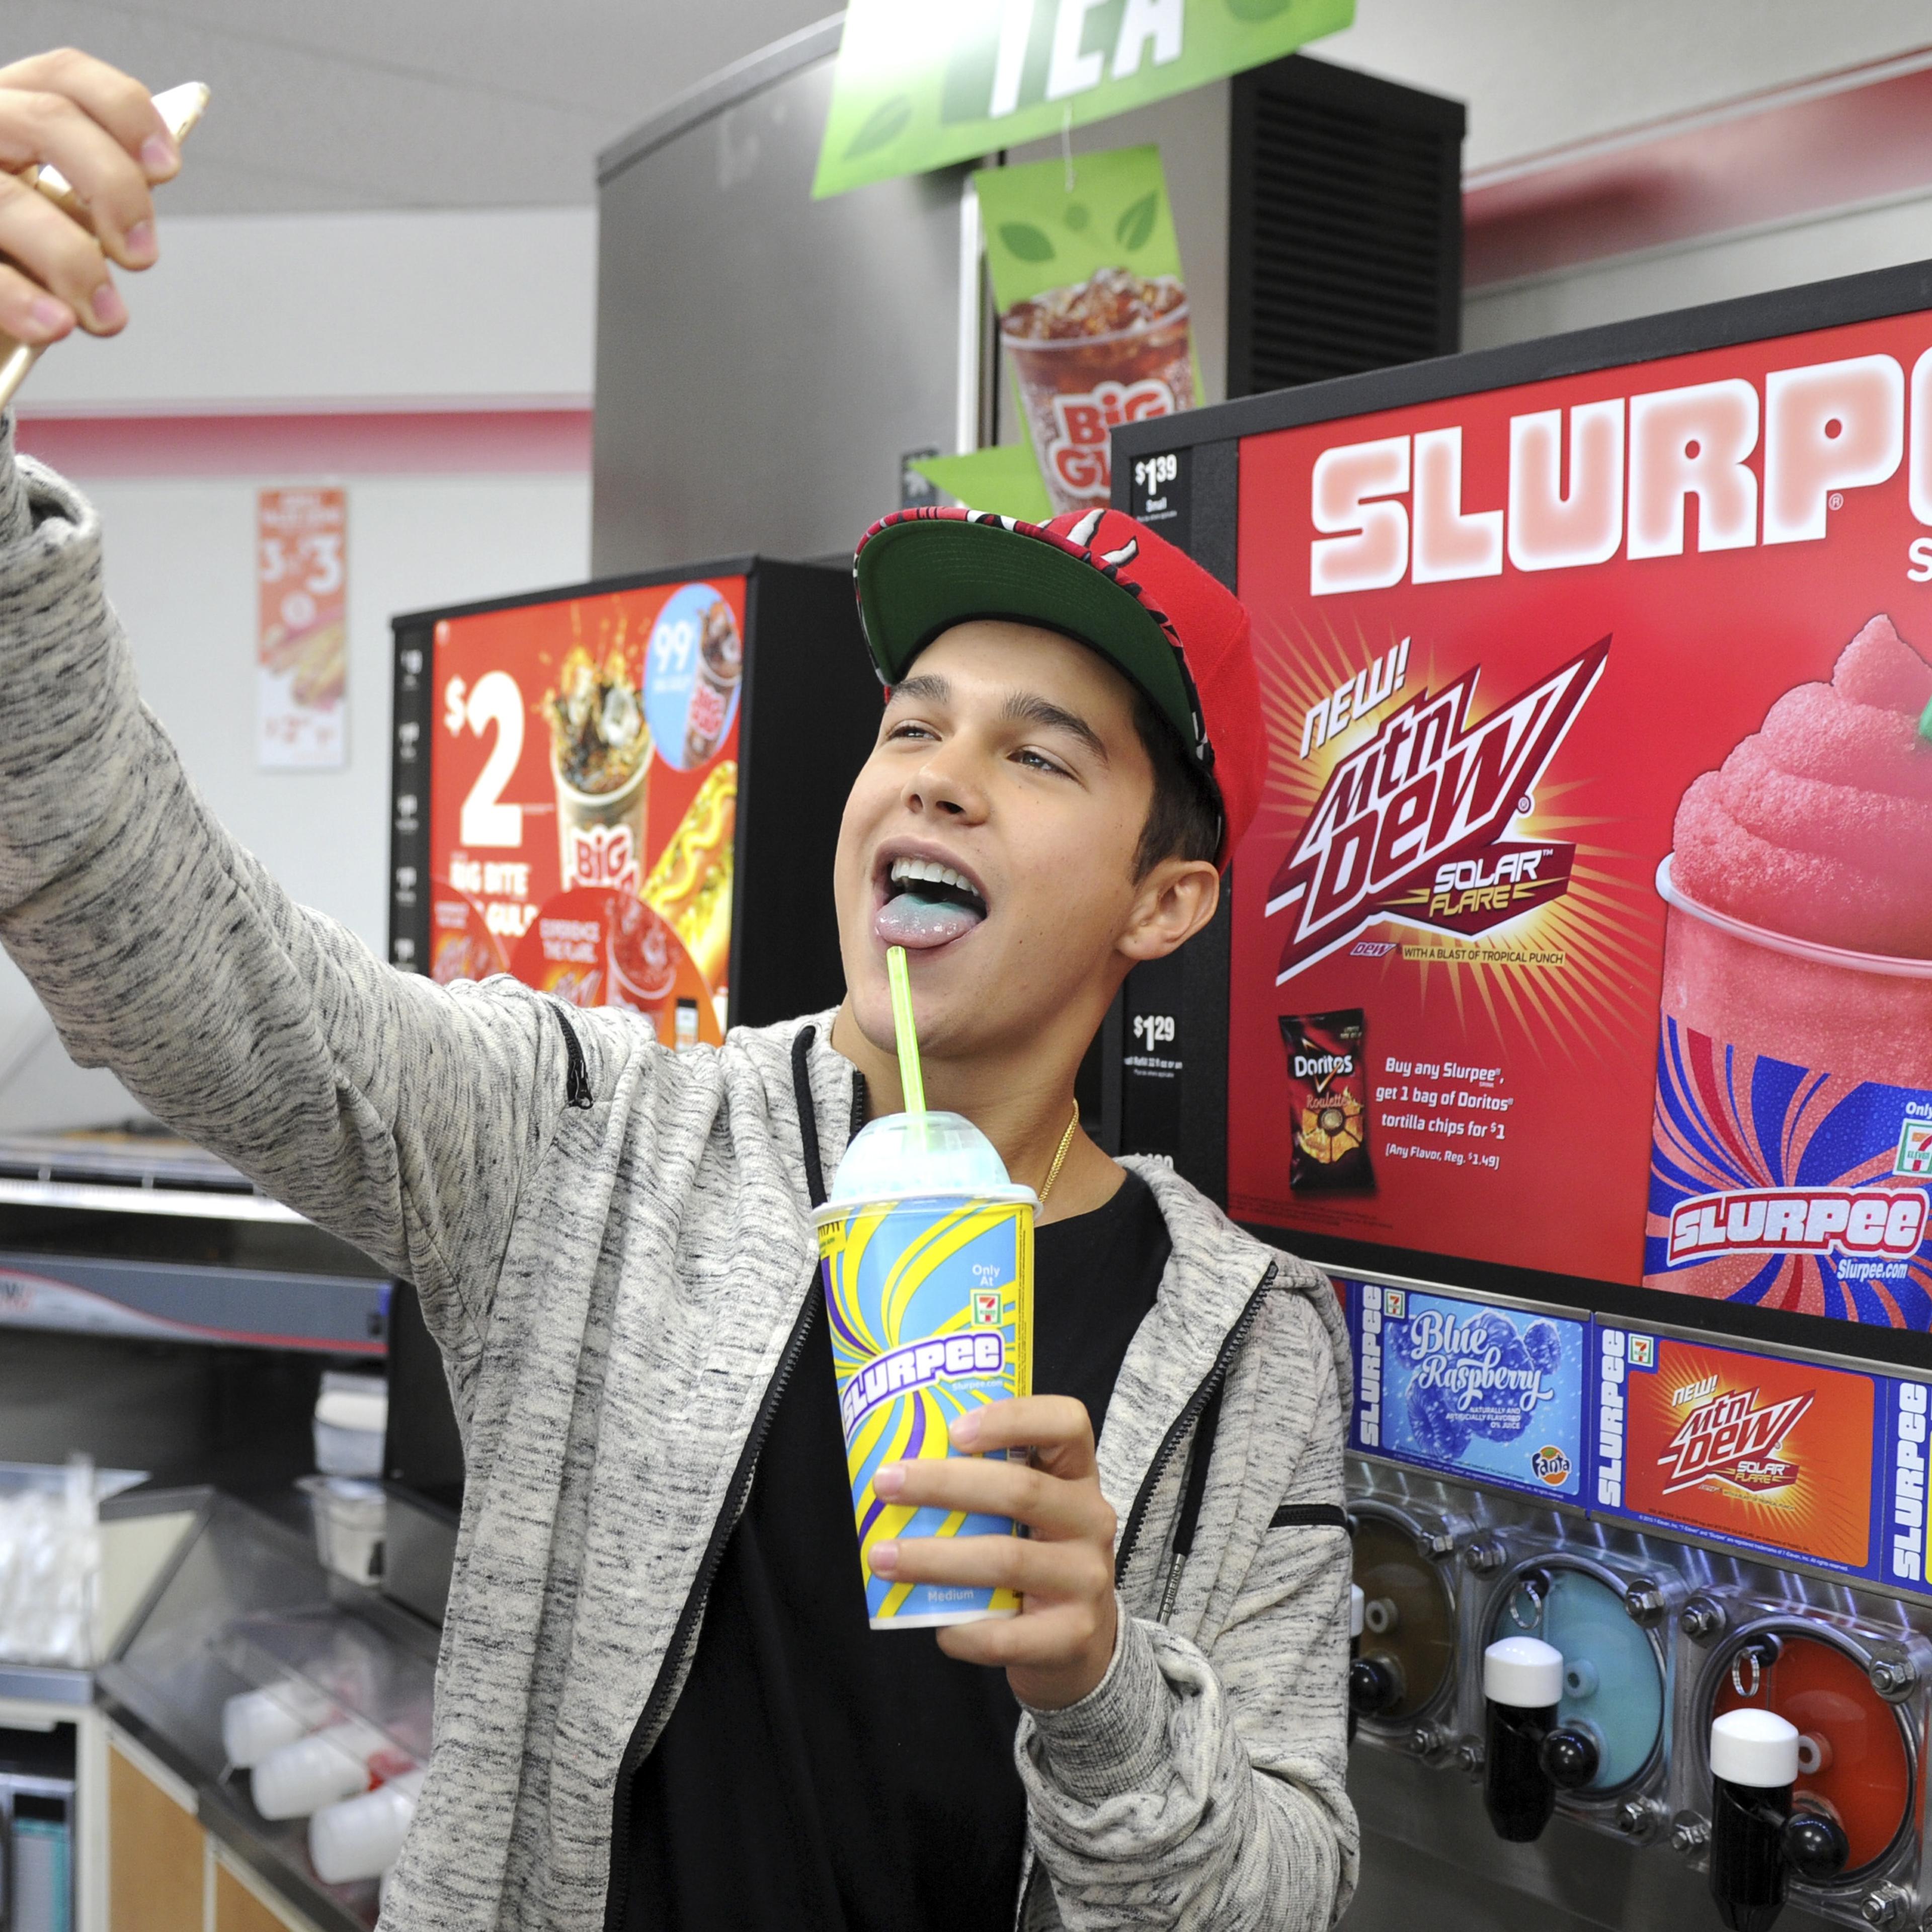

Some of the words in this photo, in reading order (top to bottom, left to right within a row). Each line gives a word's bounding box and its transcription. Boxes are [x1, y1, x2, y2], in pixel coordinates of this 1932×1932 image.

[1310, 347, 1932, 597] SLURP
[1433, 849, 1543, 894] SOLAR
[1429, 884, 1511, 918] FLARE
[1404, 947, 1427, 957] WITH
[1430, 948, 1435, 957] A
[1437, 949, 1466, 959] BLAST
[1468, 950, 1480, 960] OF
[1482, 951, 1527, 962] TROPICAL
[1529, 952, 1564, 964] PUNCH
[1295, 1055, 1353, 1078] Doritos
[1385, 1057, 1412, 1077] Buy
[1414, 1063, 1440, 1080] any
[1376, 1087, 1398, 1102] get
[1400, 1086, 1409, 1101] 1
[1412, 1087, 1438, 1107] bag
[1440, 1090, 1457, 1105] of
[1905, 1101, 1932, 1119] Only
[1382, 1113, 1426, 1131] tortilla
[1428, 1117, 1465, 1137] chips
[1468, 1121, 1488, 1137] for
[1490, 1121, 1505, 1140] $1
[1410, 1146, 1442, 1161] Flavor,
[1444, 1150, 1466, 1166] Reg.
[1672, 1199, 1923, 1253] SLURPEE
[972, 1263, 1001, 1278] Only
[980, 1276, 994, 1286] At
[1837, 1258, 1909, 1282] Slurpee.com
[1410, 1310, 1490, 1360] Blue
[1360, 1284, 1382, 1447] SLURPEE
[1419, 1346, 1555, 1412] Raspberry
[1597, 1328, 1625, 1508] SLURPEE
[1532, 1453, 1570, 1478] Fanta
[1737, 1461, 1785, 1476] SOLAR
[1735, 1474, 1772, 1484] FLARE
[1892, 1382, 1927, 1582] SLURPEE
[927, 1589, 975, 1602] Medium
